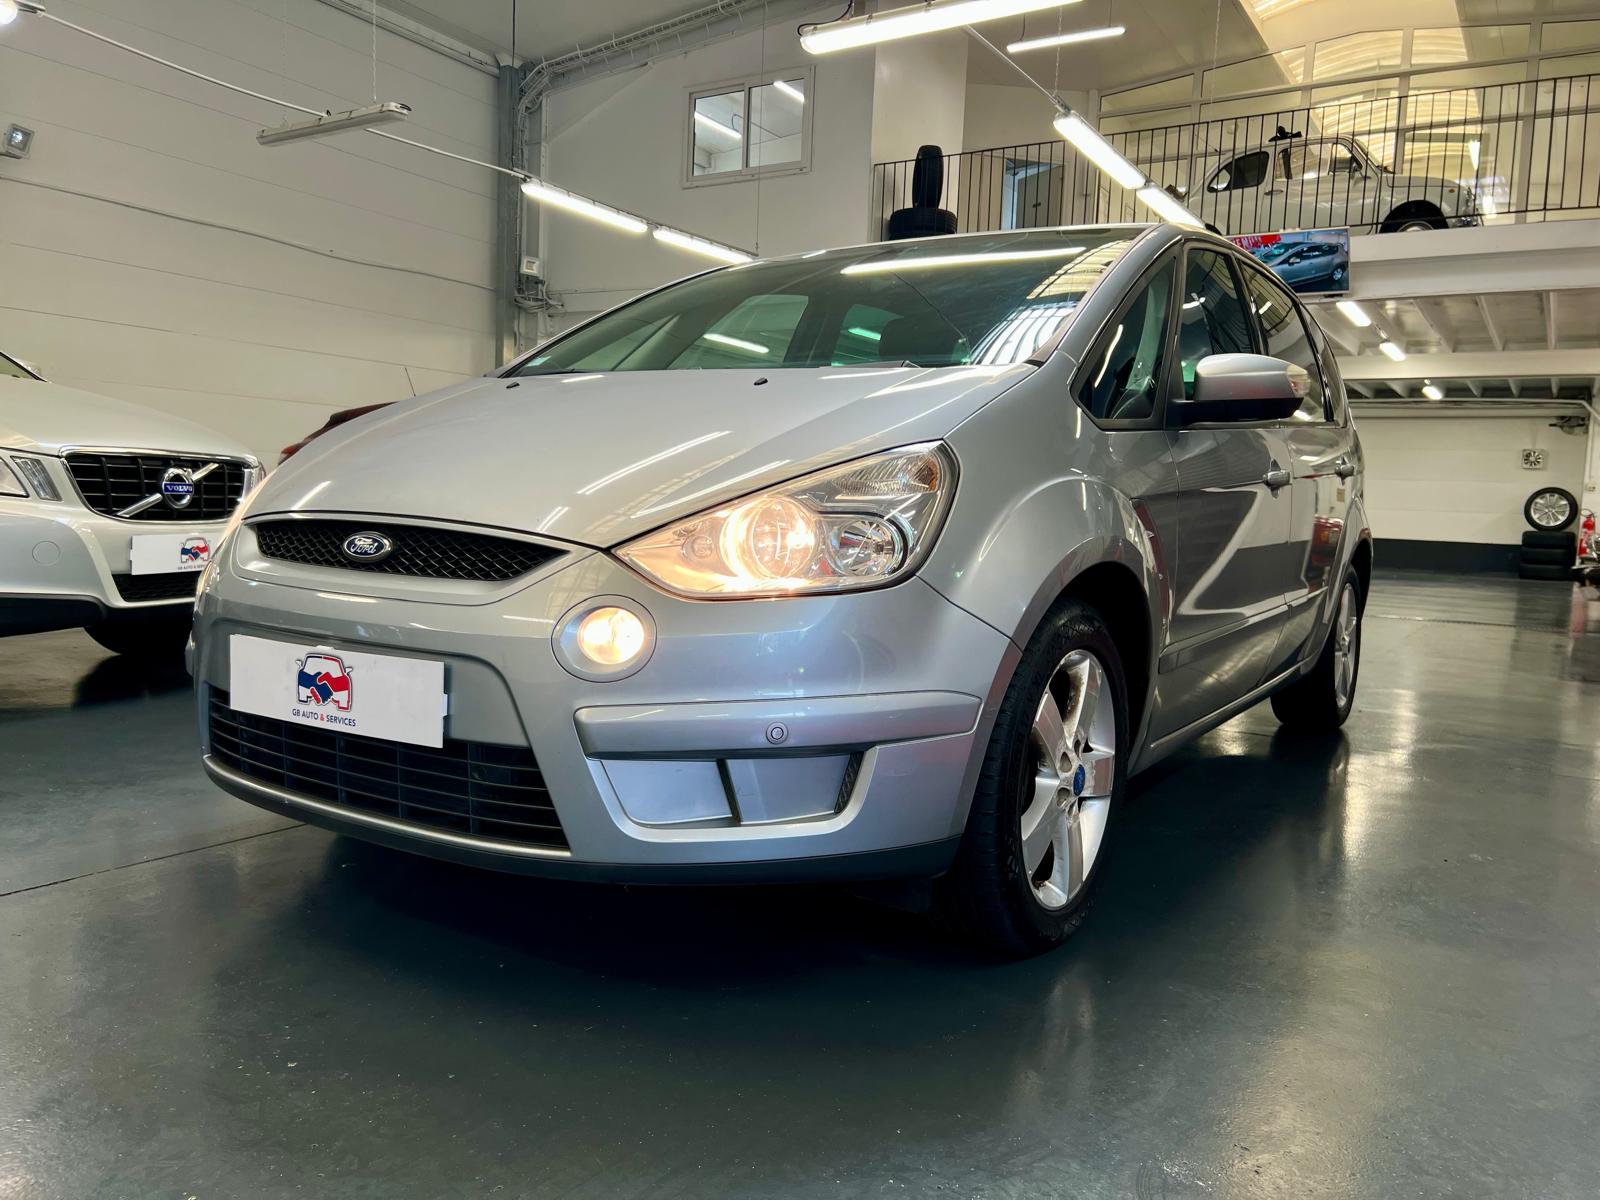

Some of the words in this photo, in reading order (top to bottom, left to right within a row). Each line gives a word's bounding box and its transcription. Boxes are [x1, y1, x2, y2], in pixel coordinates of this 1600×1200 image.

[166, 484, 193, 492] VOLVO
[350, 537, 379, 554] Ford
[291, 708, 301, 717] GB
[301, 710, 319, 721] AUTO
[320, 713, 325, 722] &
[326, 714, 357, 727] SERVICES
